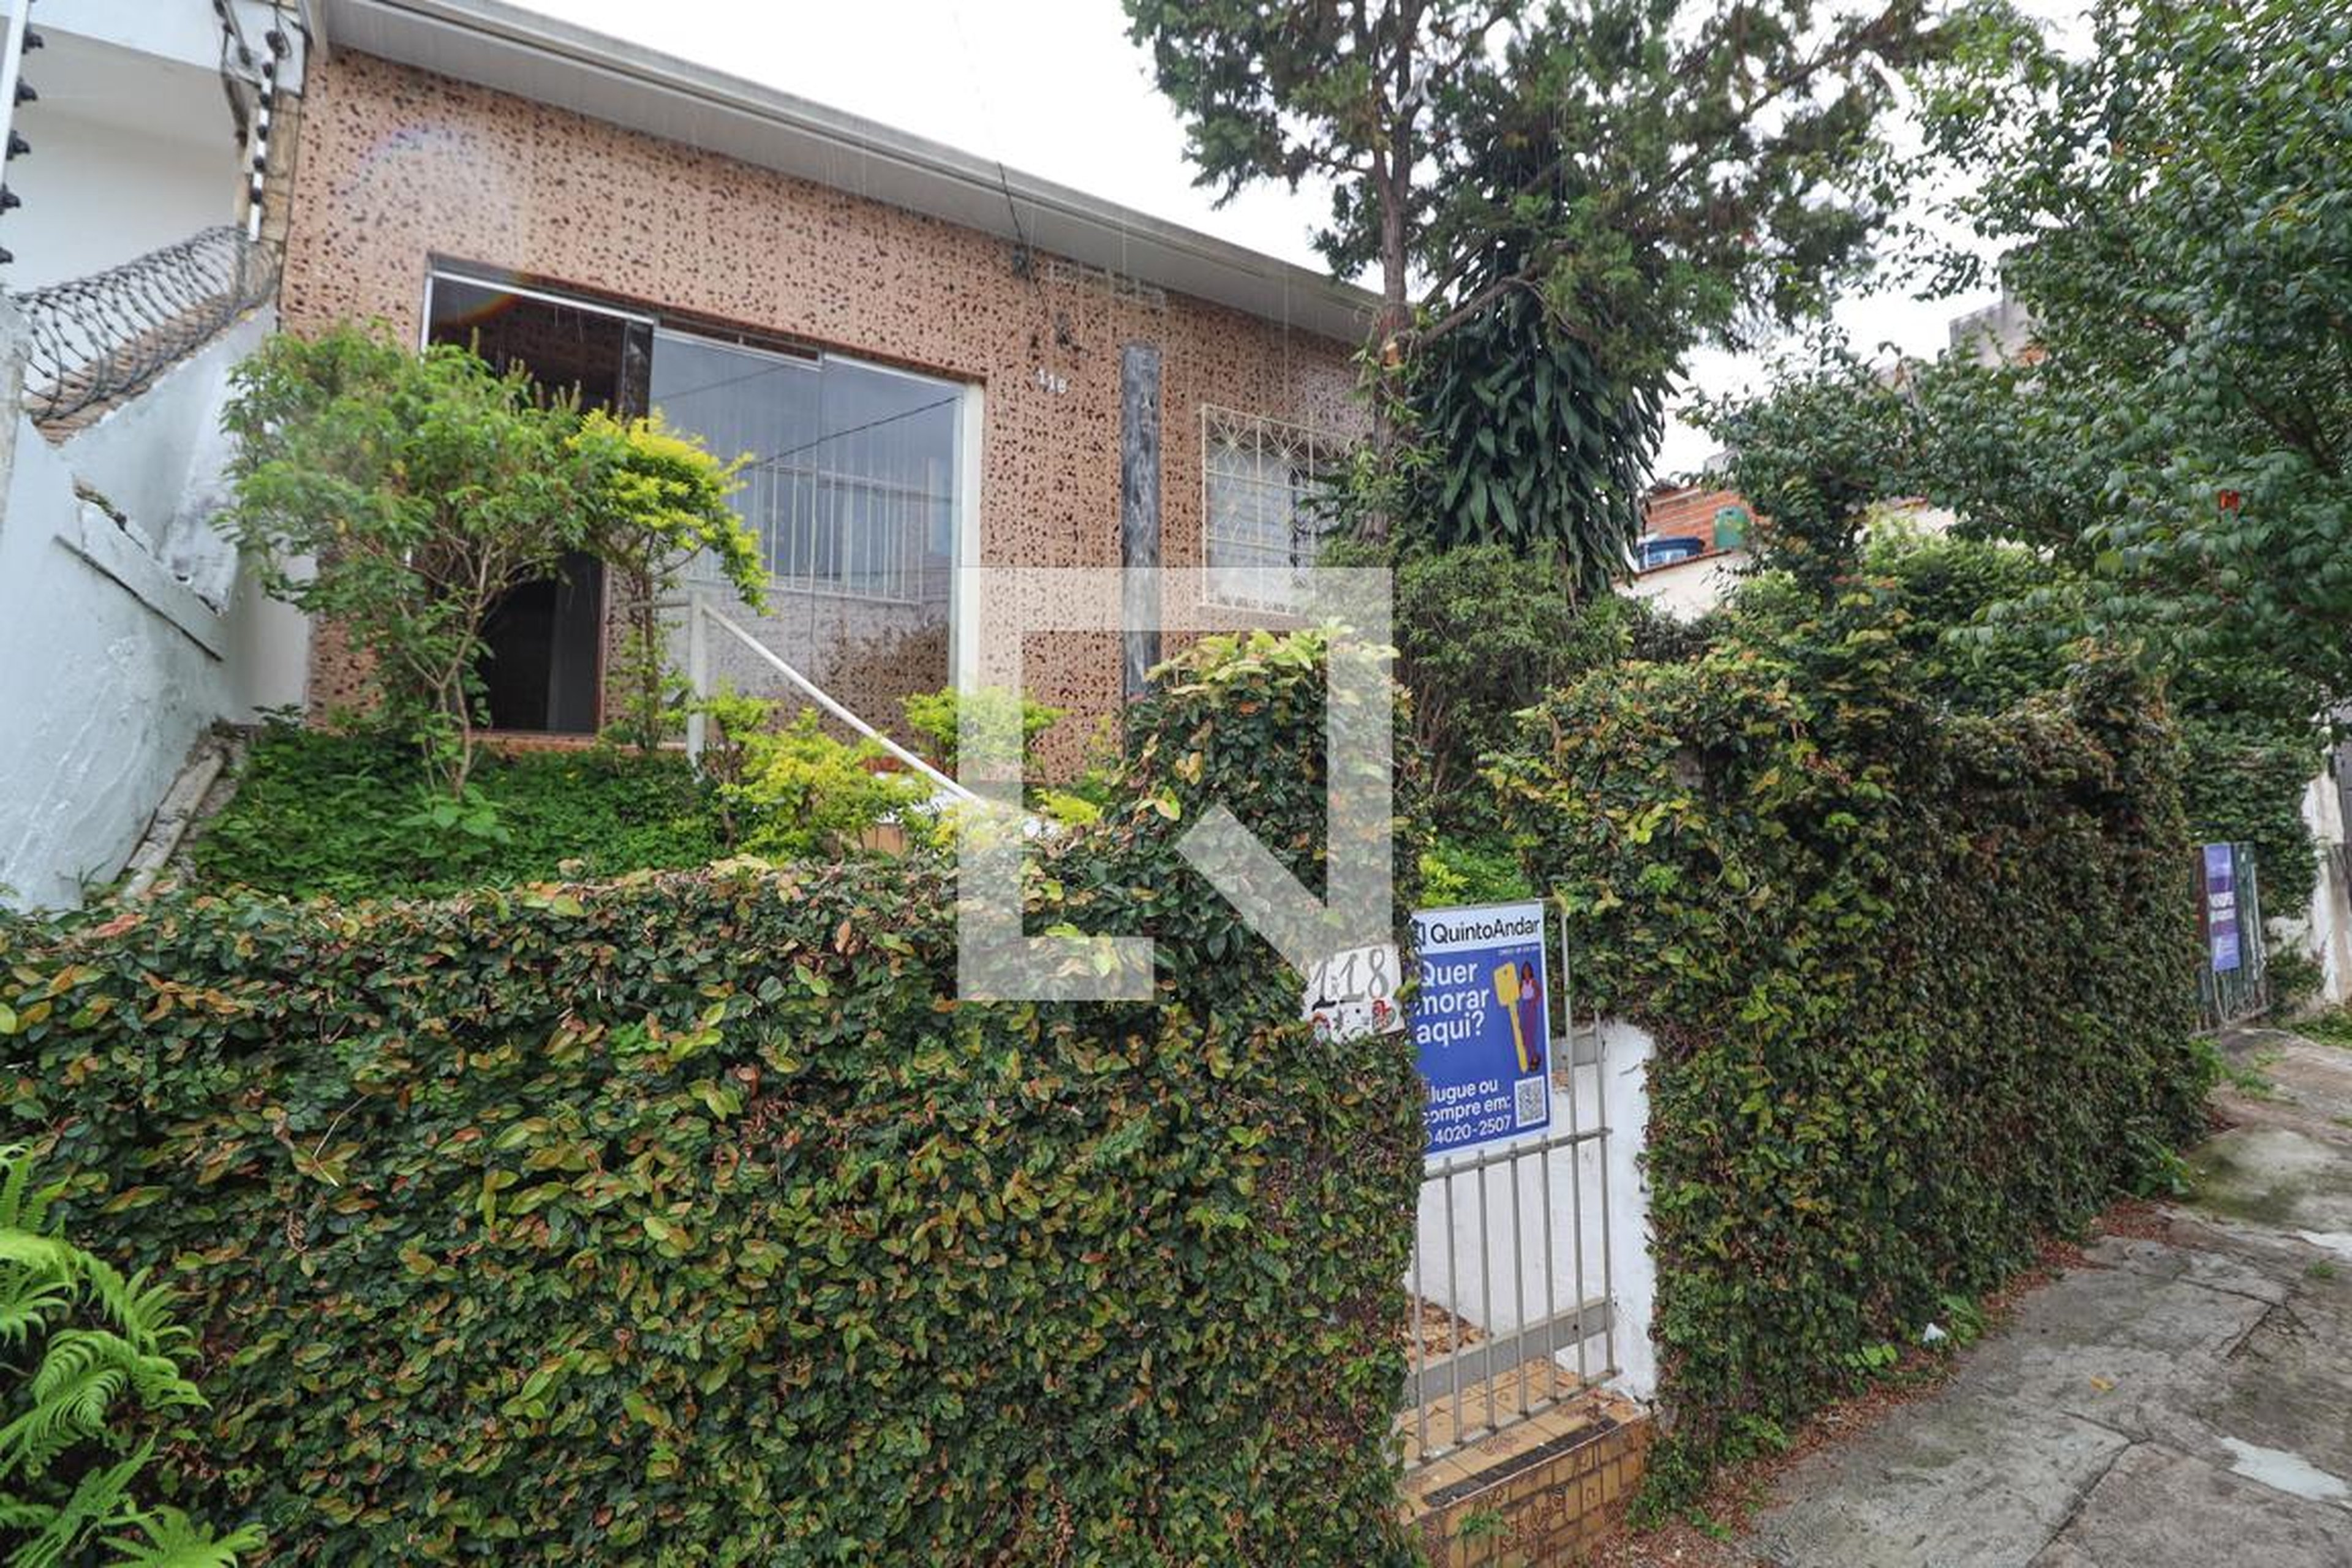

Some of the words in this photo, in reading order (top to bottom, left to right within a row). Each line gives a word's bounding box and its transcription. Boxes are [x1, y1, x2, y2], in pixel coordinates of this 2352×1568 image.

[1431, 916, 1539, 944] QuintoAndar
[1312, 949, 1389, 1011] 118
[1421, 960, 1477, 987] Quer
[1416, 989, 1489, 1016] morar
[1416, 1010, 1484, 1047] aqui?
[1430, 1083, 1476, 1105] lugue
[1479, 1079, 1498, 1093] ou
[1483, 1095, 1512, 1112] em:
[1434, 1115, 1512, 1144] 4020-2507
